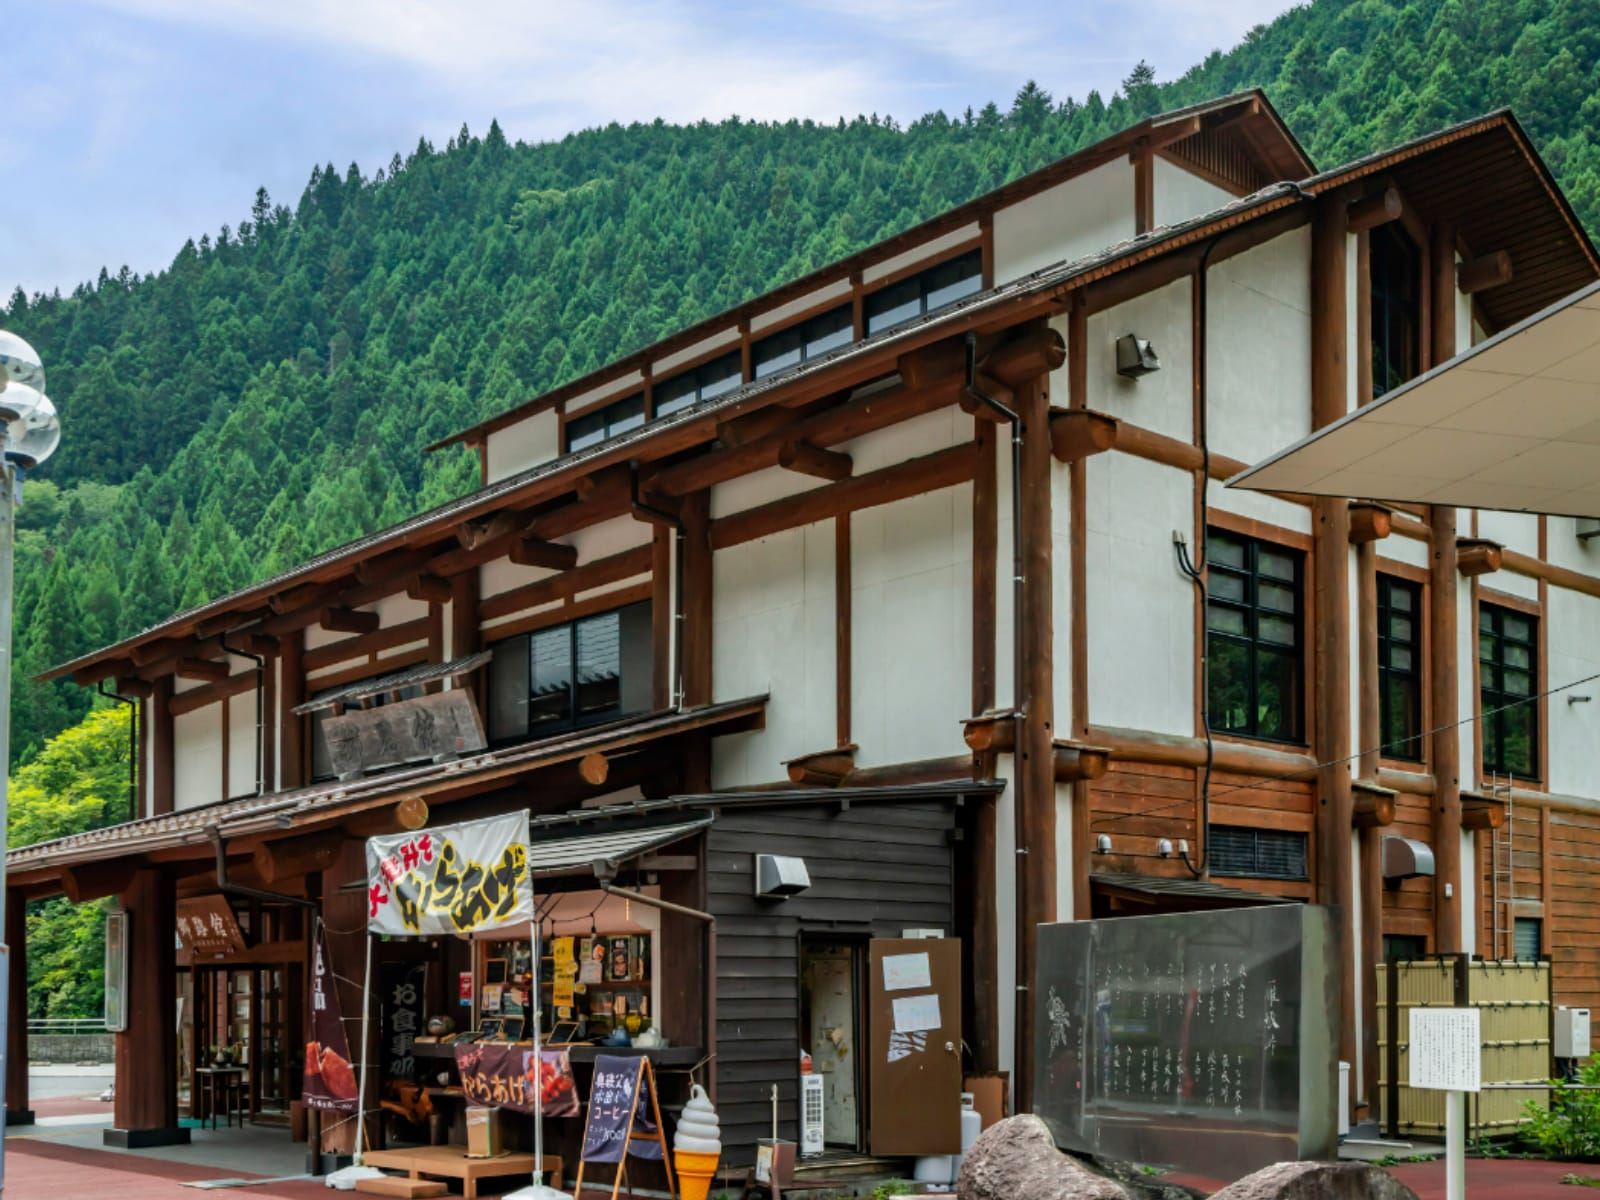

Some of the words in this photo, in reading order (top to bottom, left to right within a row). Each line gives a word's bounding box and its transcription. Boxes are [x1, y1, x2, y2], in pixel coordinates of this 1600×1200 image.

[394, 839, 527, 935] からあげ
[462, 1072, 527, 1106] からあげ
[594, 1106, 630, 1121] コーヒー
